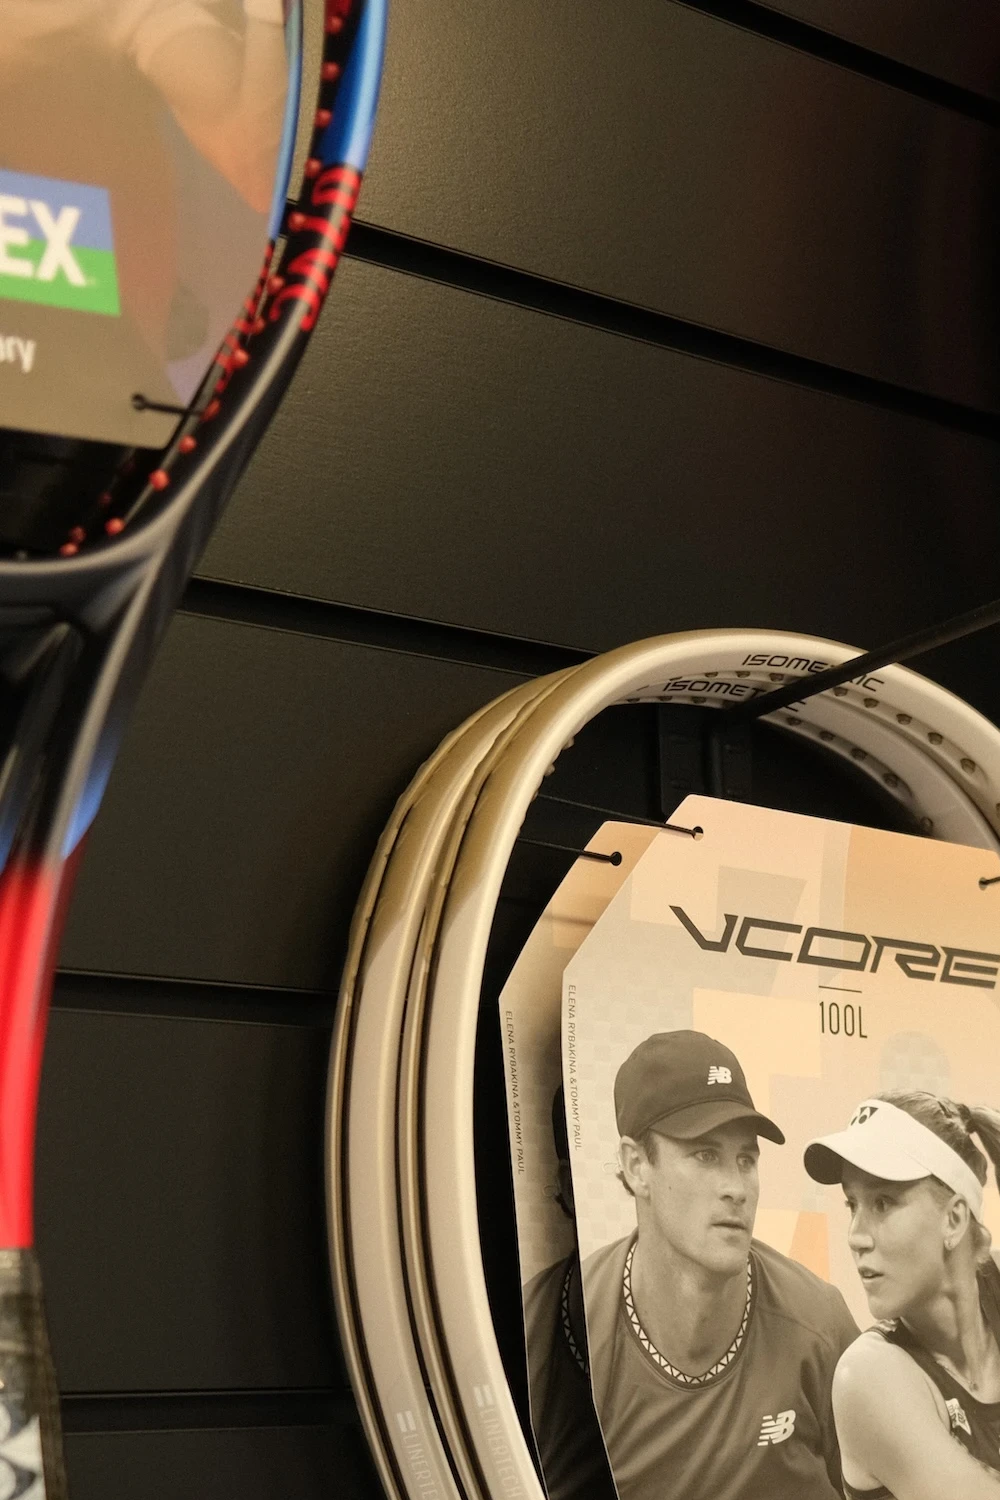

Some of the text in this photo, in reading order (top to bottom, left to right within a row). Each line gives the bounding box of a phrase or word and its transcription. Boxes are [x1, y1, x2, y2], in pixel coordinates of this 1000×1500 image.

[741, 653, 885, 693] ISOMEIC
[568, 984, 576, 1019] ELENA
[819, 1000, 869, 1038] 100L
[506, 1010, 515, 1044] ELENA
[568, 1023, 577, 1074] RYBAKINA
[508, 1048, 519, 1097] RYBAKINA
[569, 1086, 580, 1125] TOMMY
[513, 1109, 523, 1146] TOMMY
[573, 1125, 583, 1151] PAUL
[517, 1148, 526, 1175] PAUL
[480, 1406, 522, 1499] LINERTECH
